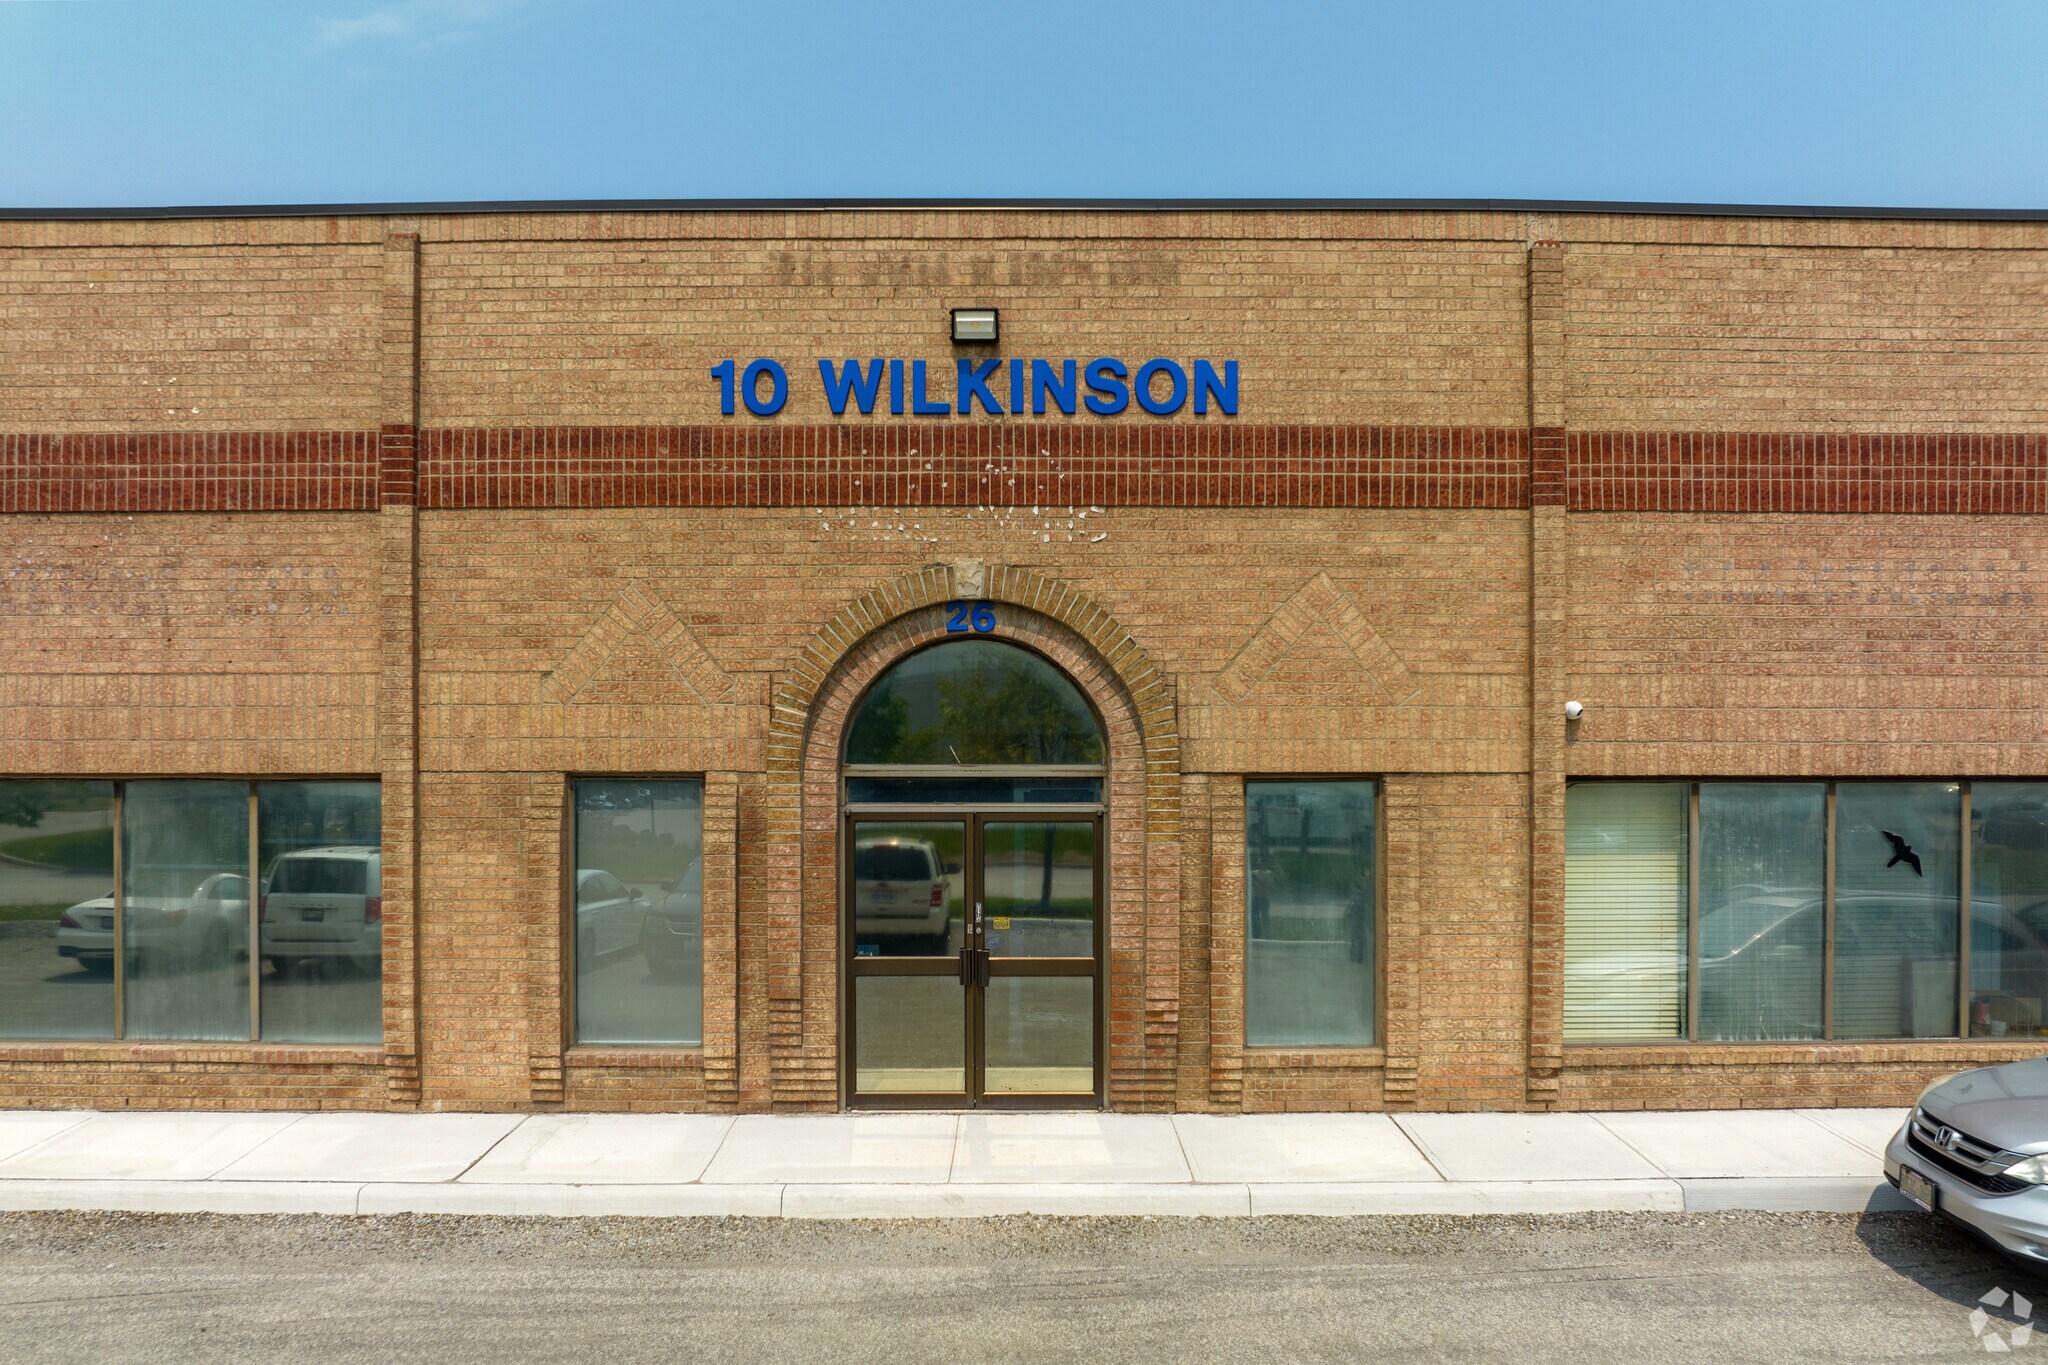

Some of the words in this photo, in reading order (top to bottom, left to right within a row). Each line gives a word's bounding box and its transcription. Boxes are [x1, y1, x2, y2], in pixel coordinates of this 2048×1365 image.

[711, 357, 788, 416] 10
[818, 357, 1239, 416] WILKINSON
[946, 601, 996, 632] 26
